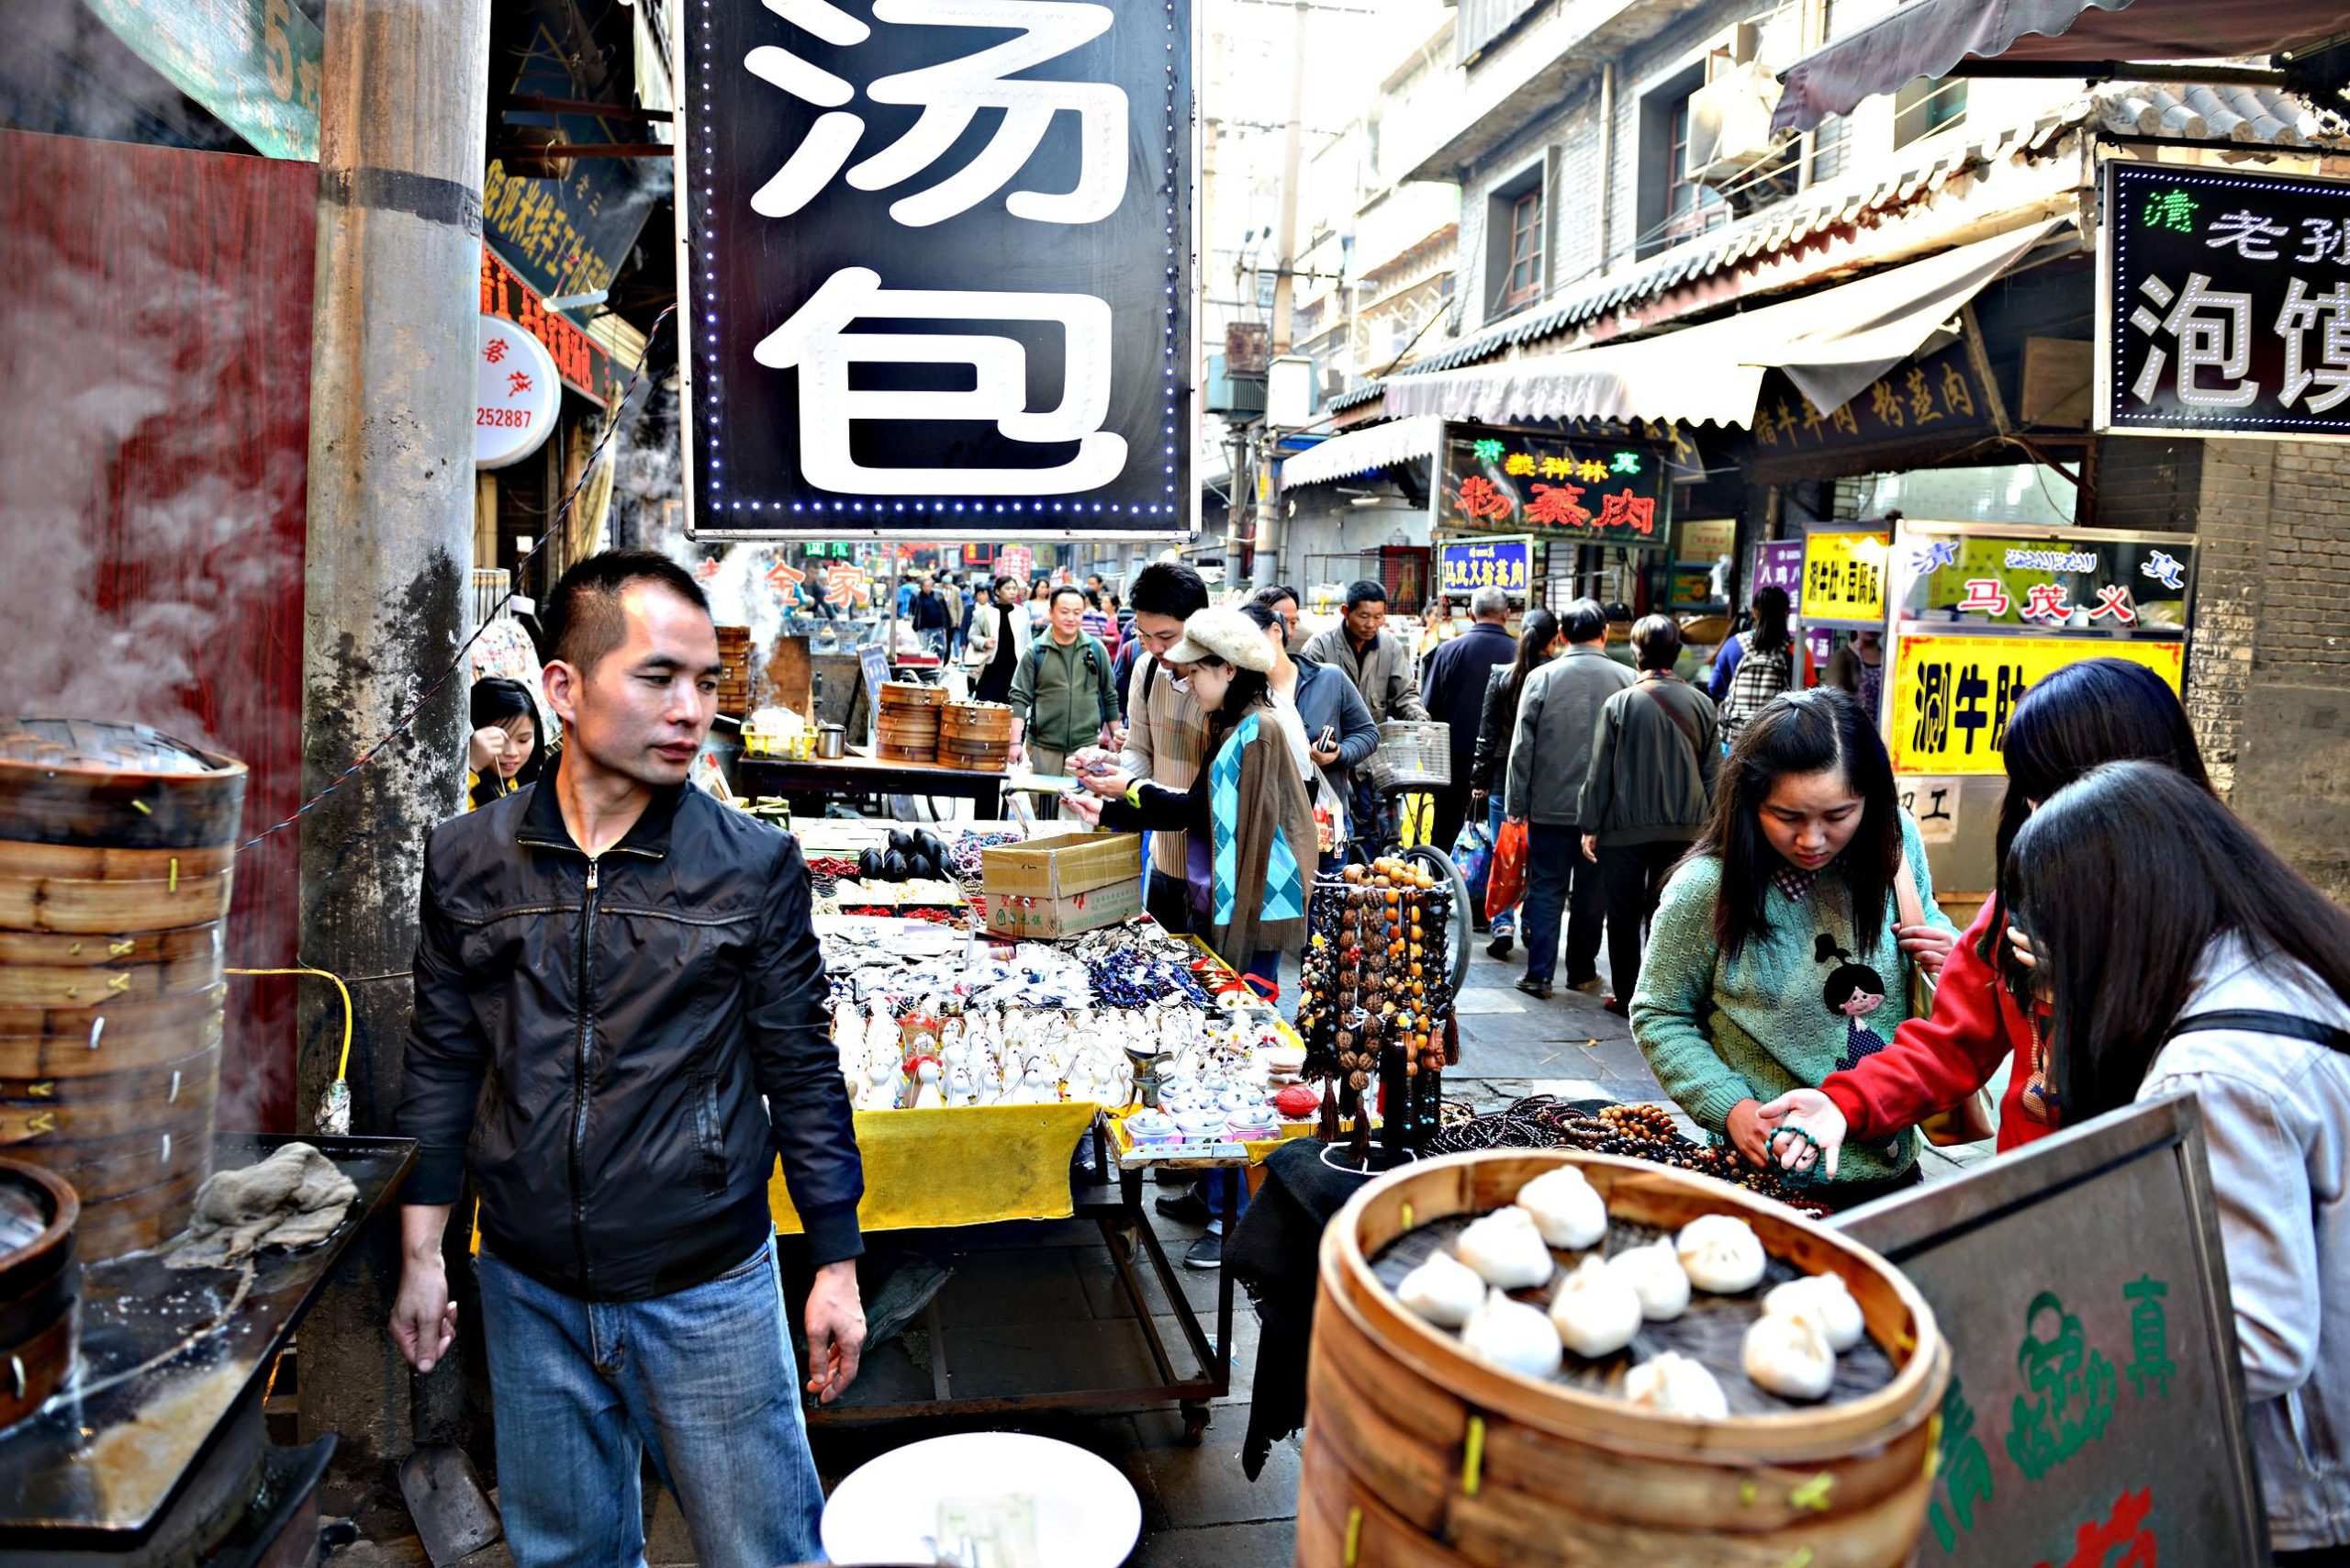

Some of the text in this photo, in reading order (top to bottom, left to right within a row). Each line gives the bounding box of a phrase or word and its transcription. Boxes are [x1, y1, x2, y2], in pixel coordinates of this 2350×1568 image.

[744, 0, 1129, 496] 汤包
[476, 407, 532, 429] 252887
[1956, 577, 2138, 624] 马茂义
[2121, 1272, 2177, 1400] 真
